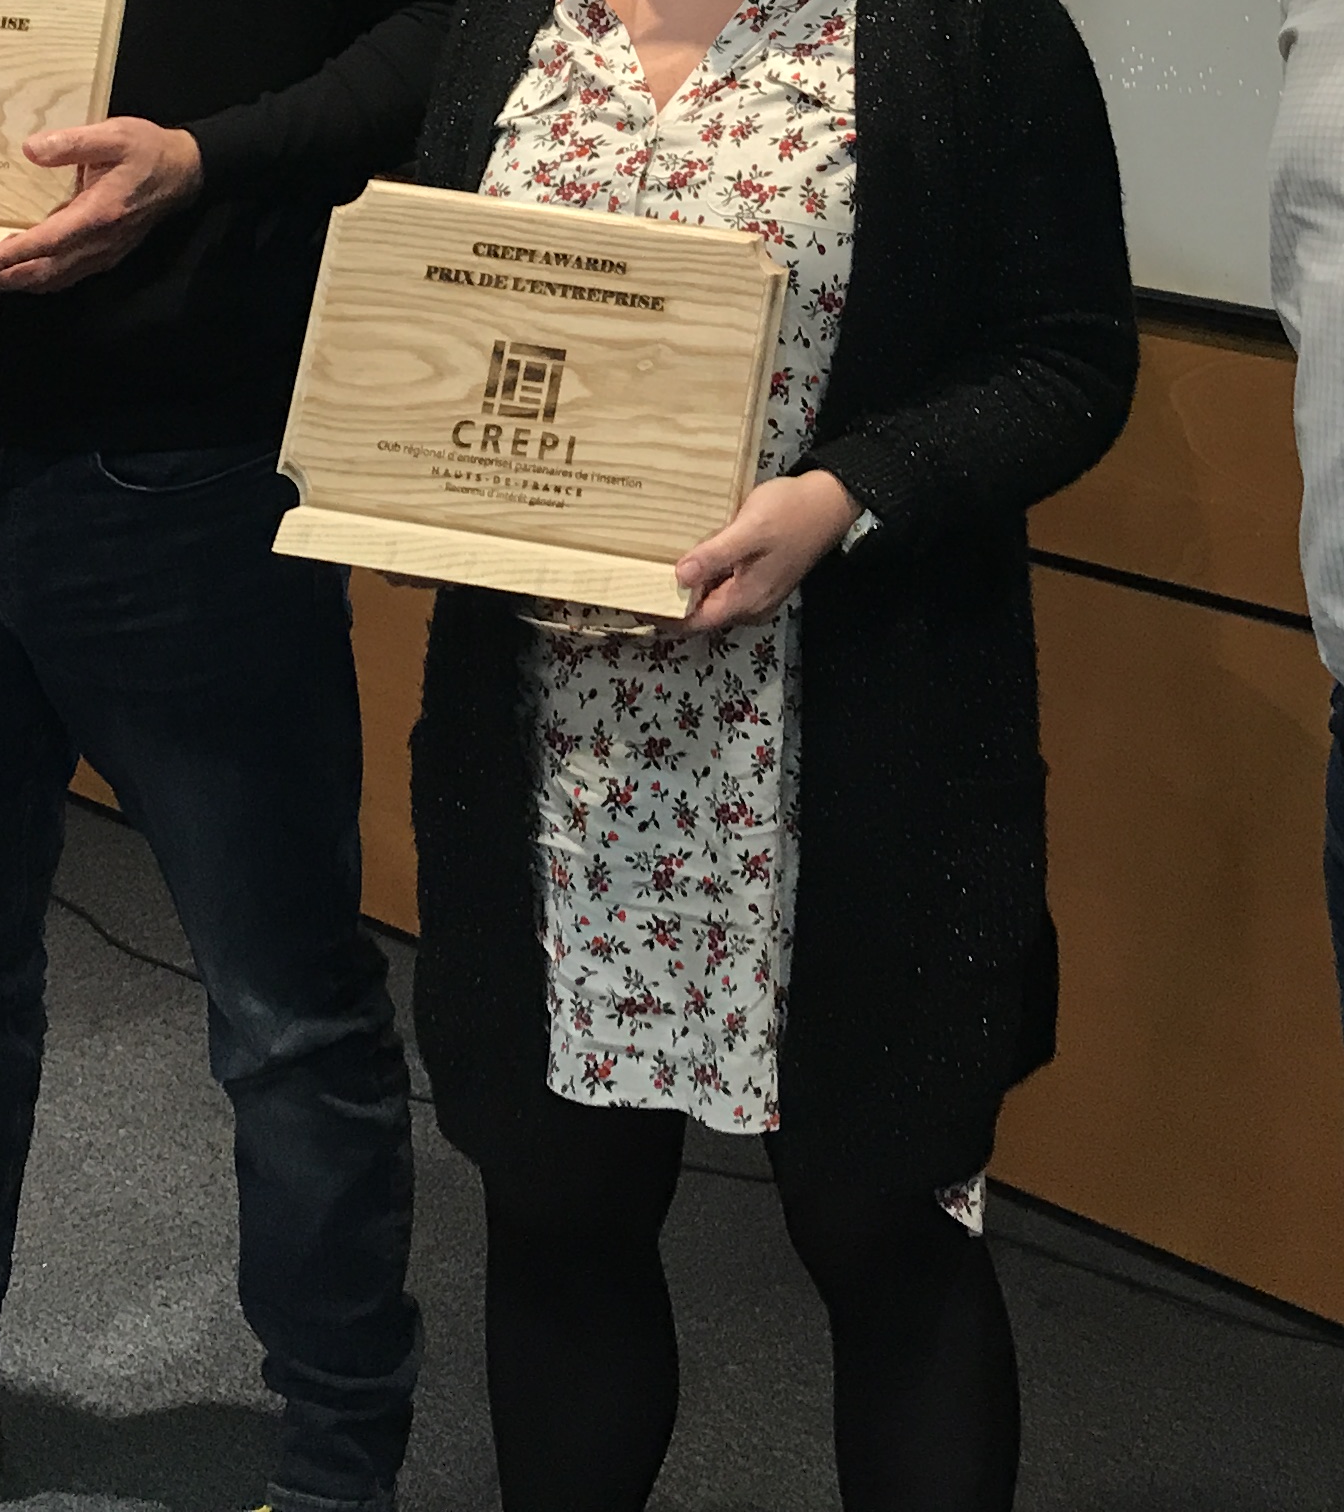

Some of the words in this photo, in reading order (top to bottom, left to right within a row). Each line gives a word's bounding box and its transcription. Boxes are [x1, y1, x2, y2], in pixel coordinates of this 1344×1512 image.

[472, 241, 539, 263] CREPI
[539, 250, 628, 275] AWARDS
[424, 265, 476, 286] PRIX
[478, 271, 507, 290] DE
[510, 276, 666, 312] L'ENTREPRISE
[377, 440, 401, 453] Club
[403, 445, 446, 459] régional
[514, 462, 573, 479] partenaires
[575, 469, 588, 481] de
[590, 472, 642, 489] l'insertion
[451, 420, 576, 465] CREPI
